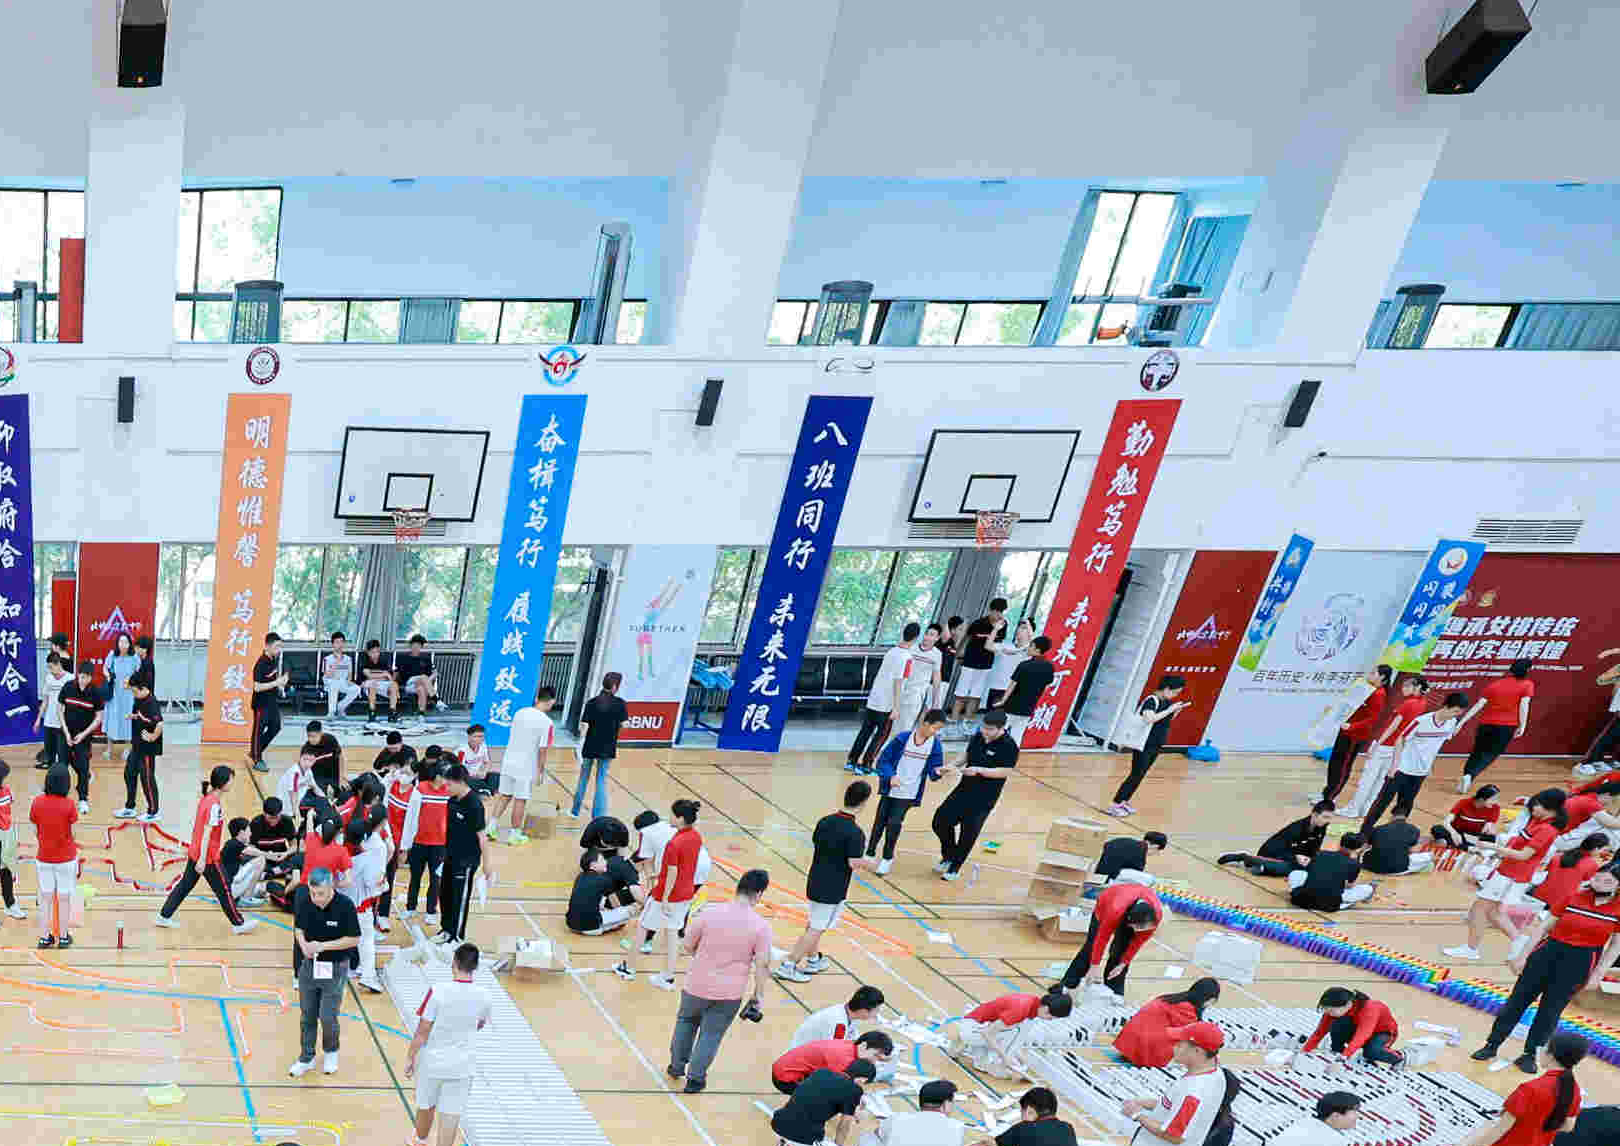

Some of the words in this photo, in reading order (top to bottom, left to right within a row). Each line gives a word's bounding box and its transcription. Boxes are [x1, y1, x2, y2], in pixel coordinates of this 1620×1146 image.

[516, 414, 567, 568] 奋楫笃行
[783, 422, 848, 570] 八班同行
[1084, 419, 1155, 574] 勤勉笃行
[488, 591, 531, 727] 履践致远
[741, 593, 795, 732] 未来无限
